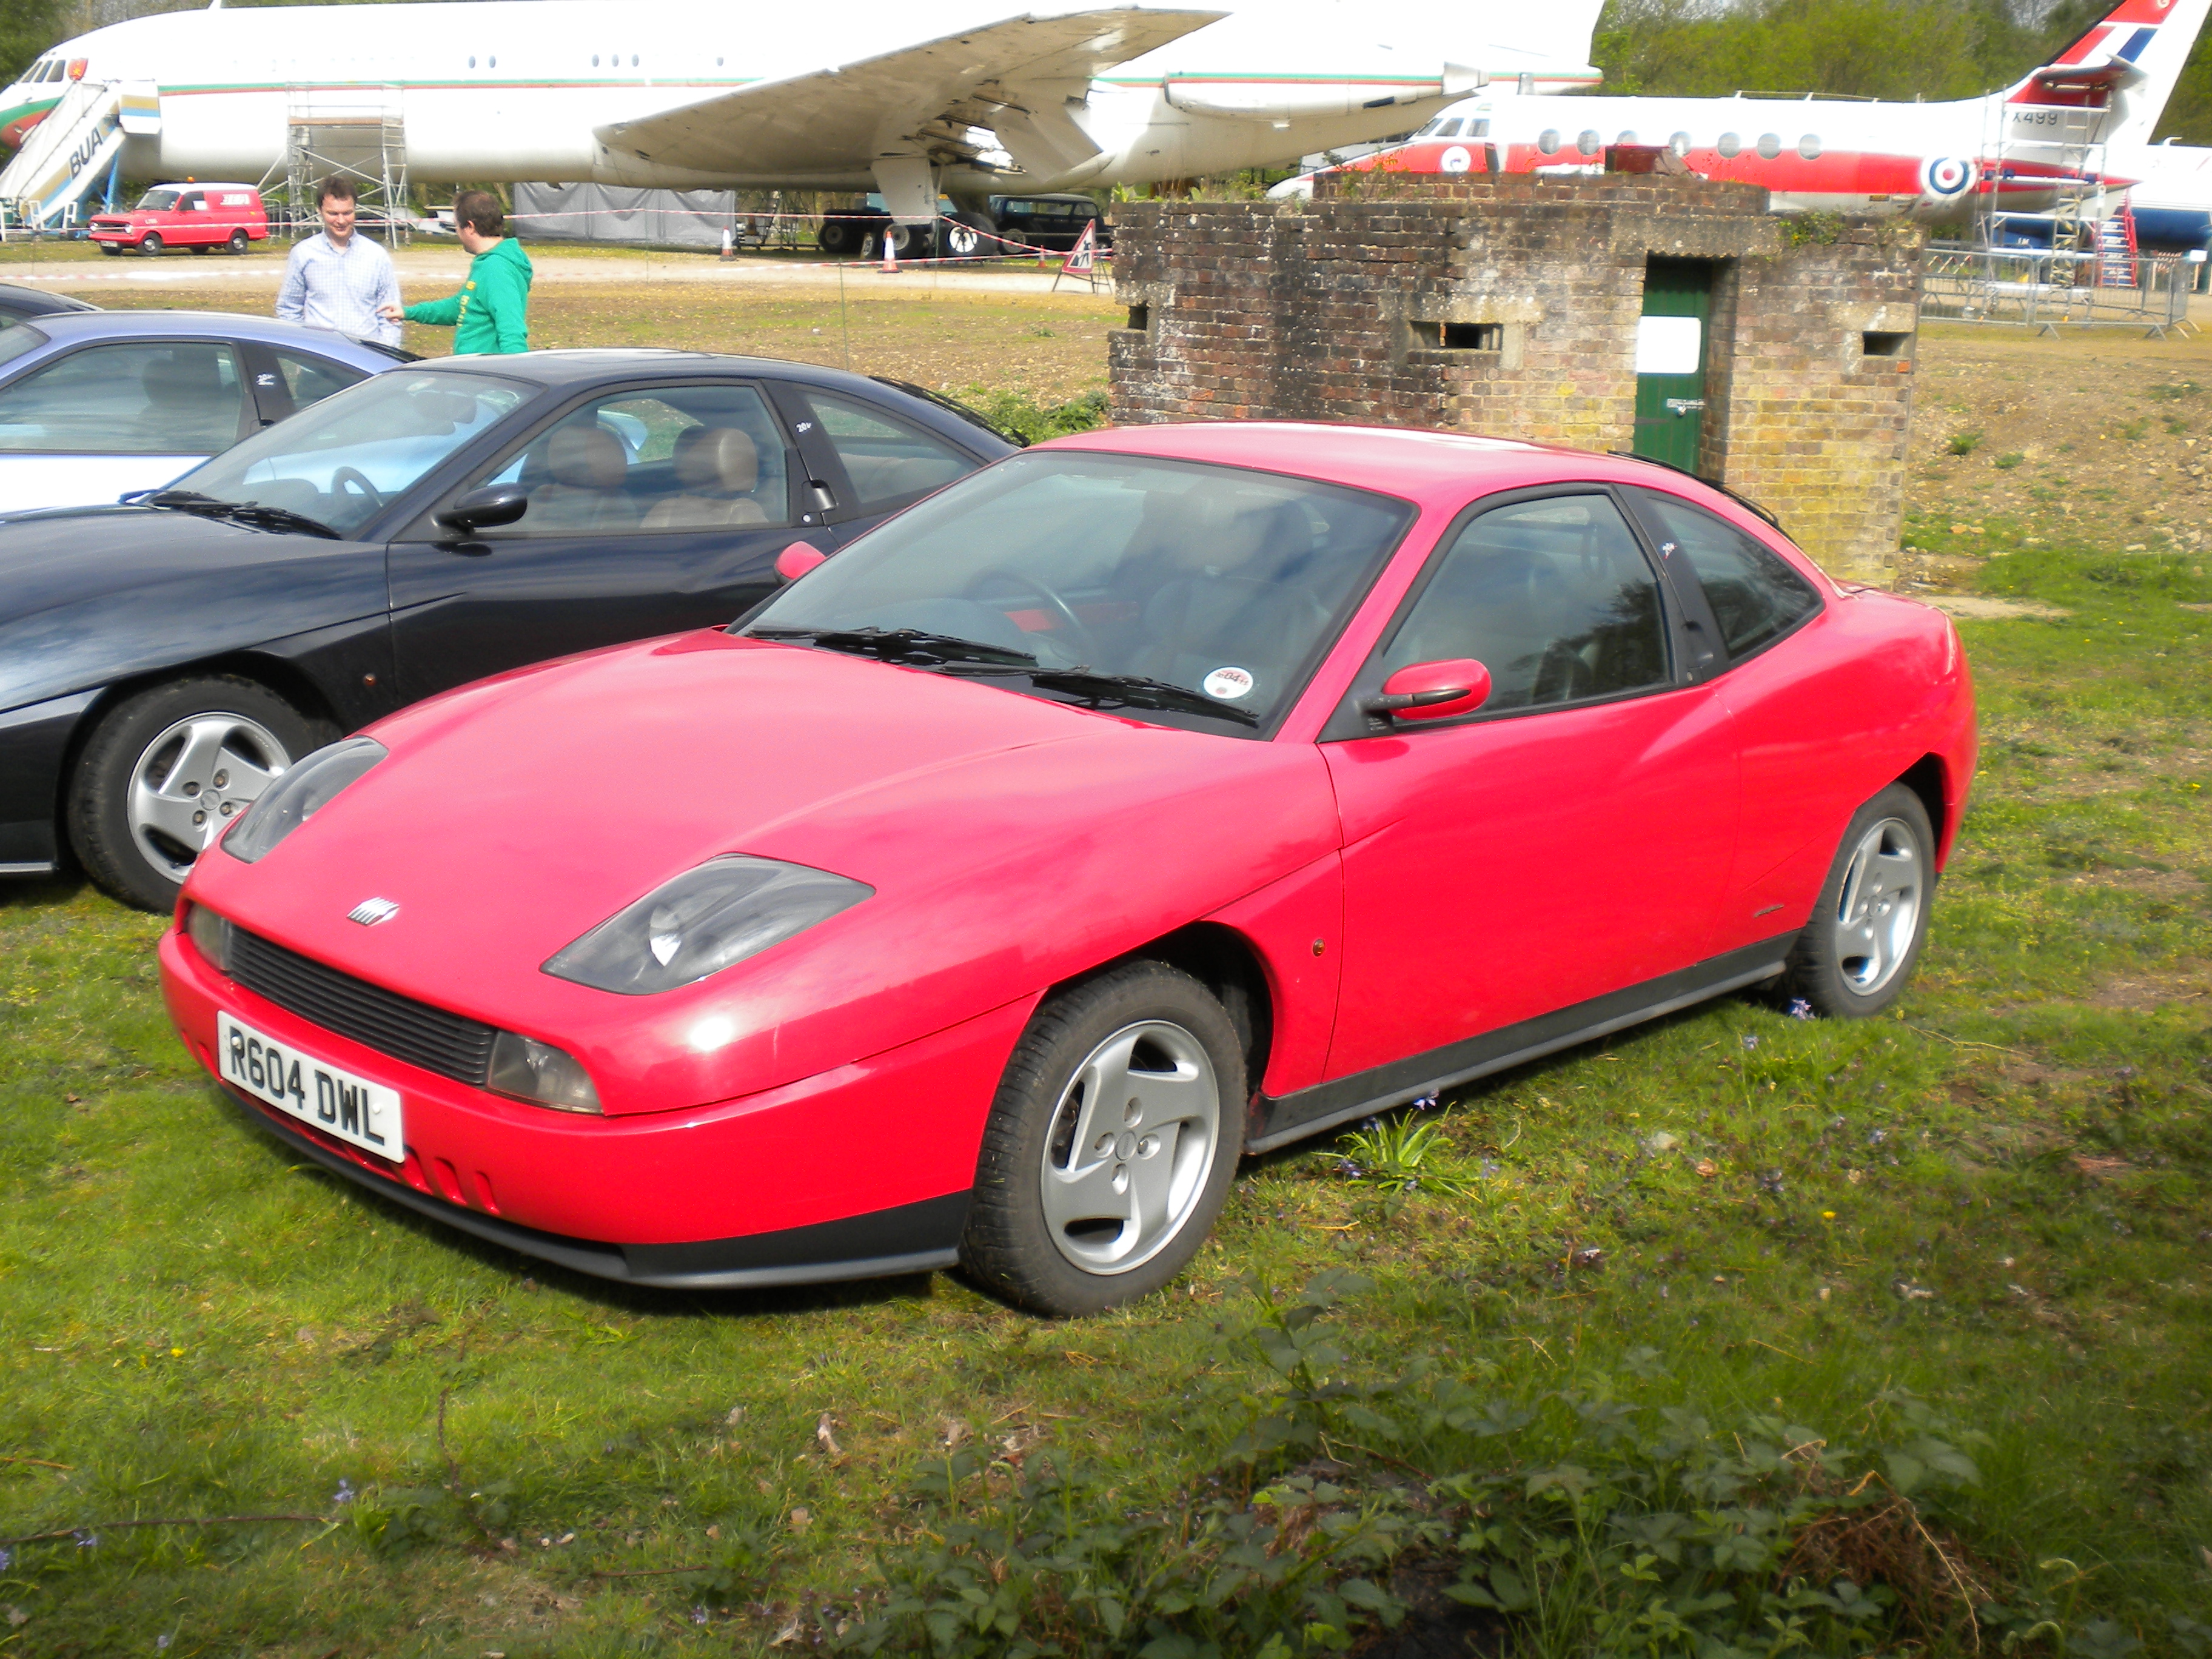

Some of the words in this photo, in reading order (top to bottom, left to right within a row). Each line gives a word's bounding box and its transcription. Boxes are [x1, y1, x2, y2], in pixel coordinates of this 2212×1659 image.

[70, 127, 102, 179] BUA
[229, 1025, 306, 1110] R604
[314, 1069, 385, 1146] DWL
